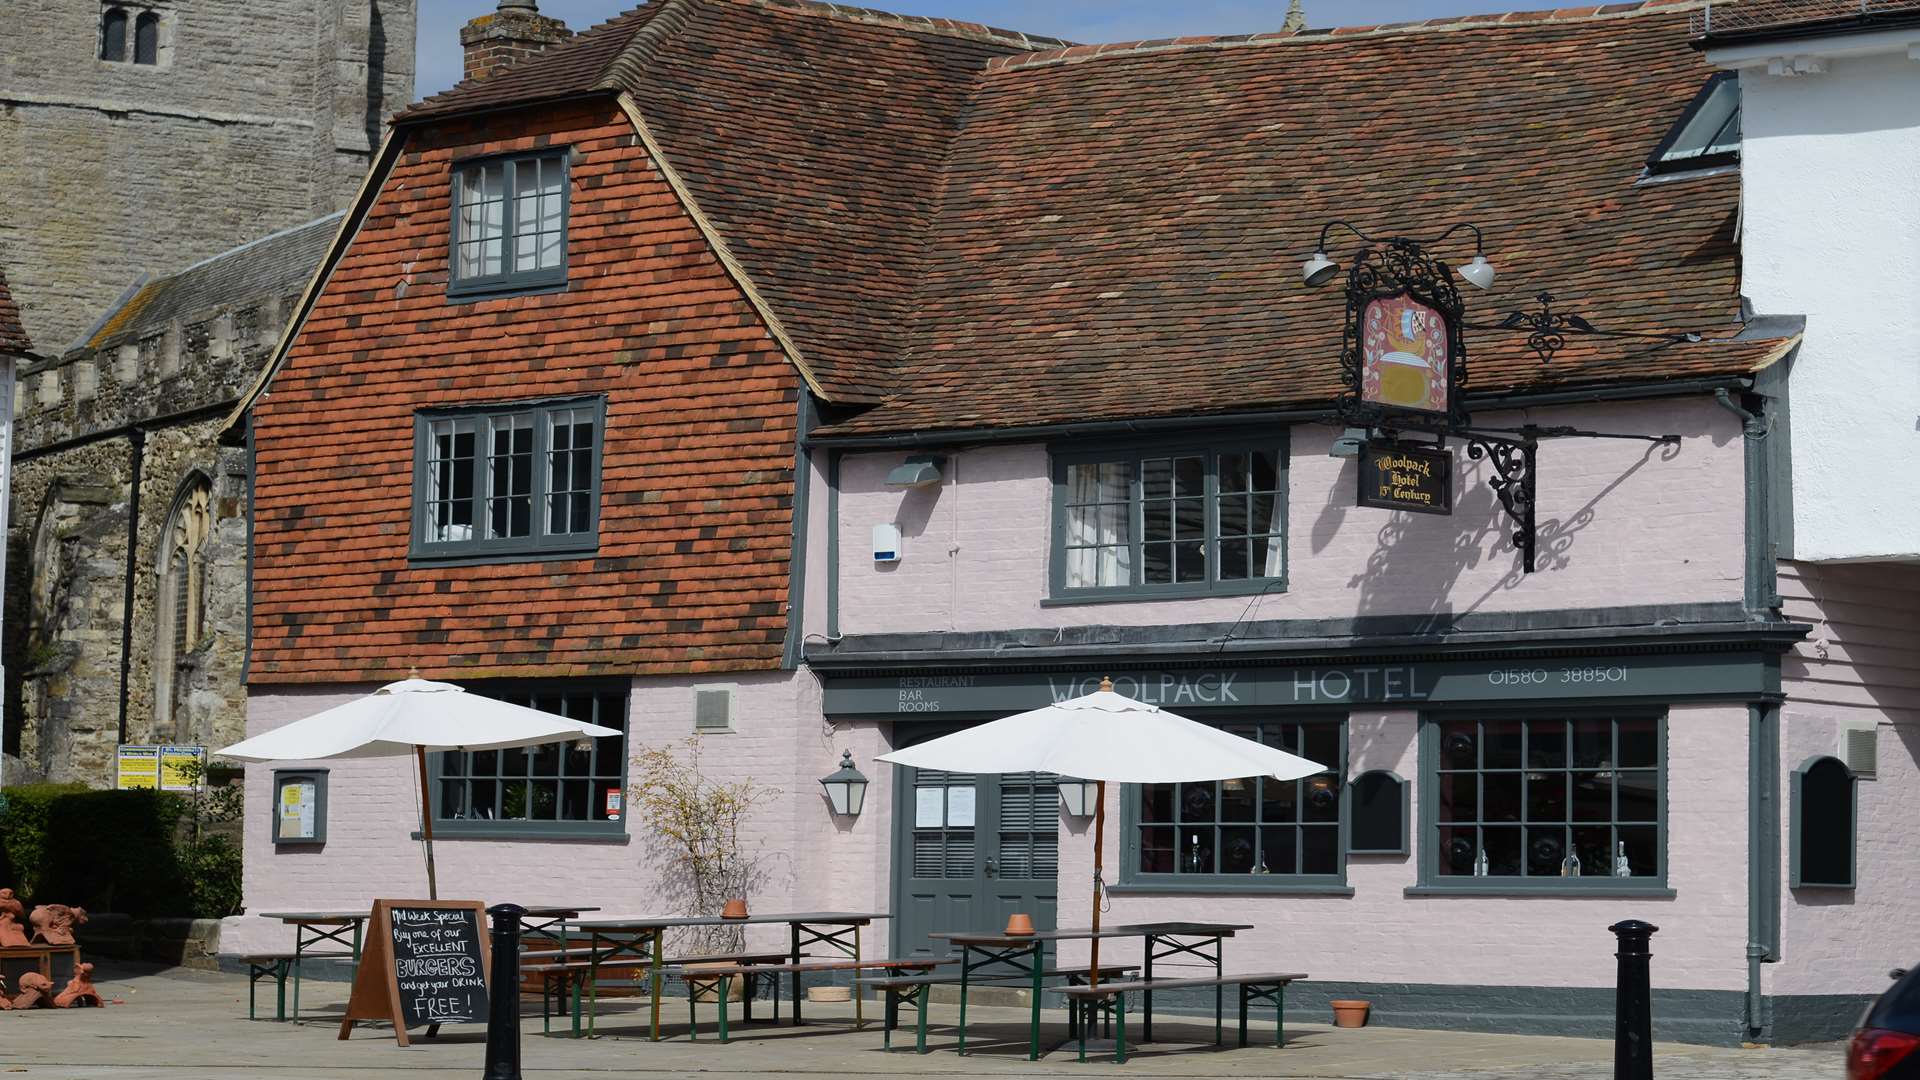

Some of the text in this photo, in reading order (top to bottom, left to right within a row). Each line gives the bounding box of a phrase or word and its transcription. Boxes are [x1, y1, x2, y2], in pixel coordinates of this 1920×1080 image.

[1375, 456, 1431, 477] Woolpack
[1391, 471, 1419, 487] Hotel
[1394, 488, 1431, 505] Century
[899, 676, 976, 688] RESTAURANT
[1294, 667, 1427, 700] HOTEL
[1488, 665, 1627, 685] 01580 388501
[899, 690, 923, 701] BAR
[898, 701, 940, 712] ROOMS
[408, 910, 430, 921] Week
[433, 911, 465, 925] Special
[394, 929, 461, 948] Buy one of our
[412, 941, 469, 954] EXCELLENT
[395, 957, 476, 977] BURGERS
[401, 977, 485, 997] and get your DRINK
